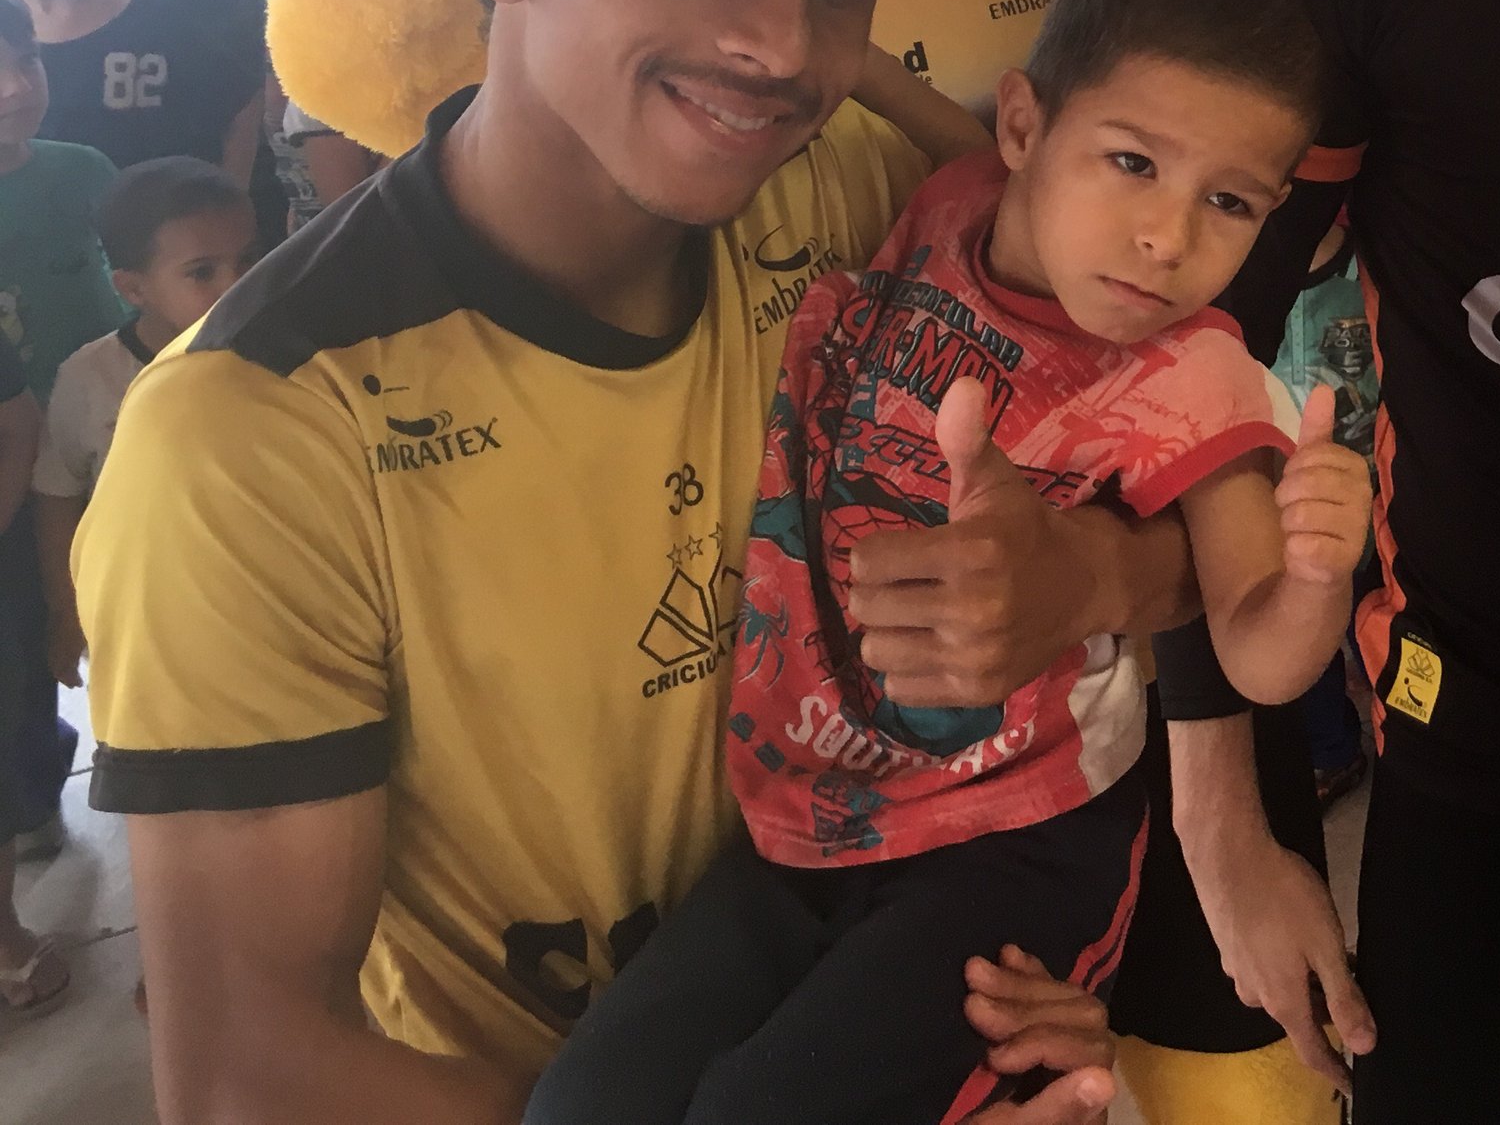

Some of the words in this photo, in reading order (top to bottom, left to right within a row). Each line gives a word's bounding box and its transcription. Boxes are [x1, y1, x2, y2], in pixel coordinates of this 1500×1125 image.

[103, 51, 168, 109] 82
[664, 463, 704, 515] 38
[641, 651, 718, 699] CRICIU
